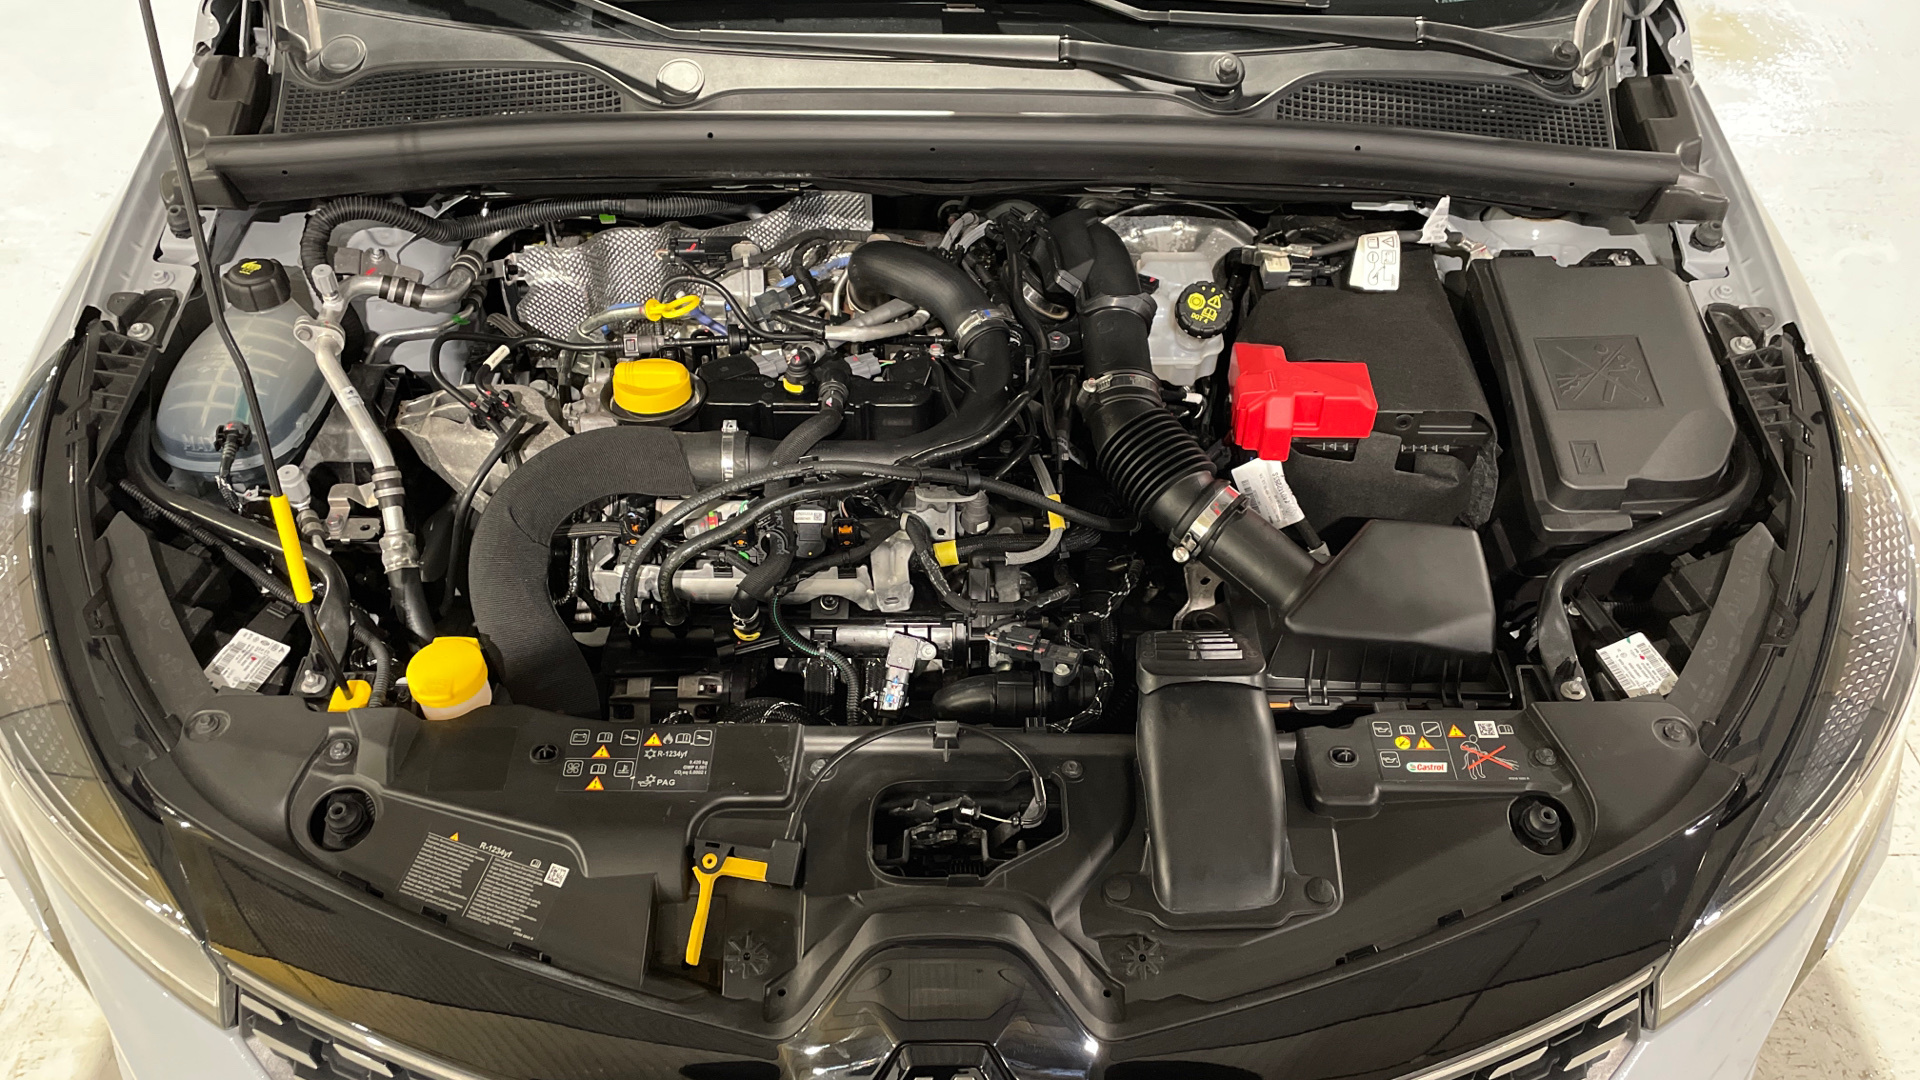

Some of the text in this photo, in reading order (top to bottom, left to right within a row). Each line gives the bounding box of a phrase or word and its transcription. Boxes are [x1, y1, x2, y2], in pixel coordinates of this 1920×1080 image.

[1191, 312, 1203, 321] DOT
[657, 750, 688, 759] R-1234yf
[1416, 763, 1444, 771] Castrol
[479, 841, 513, 859] R-1234yf
